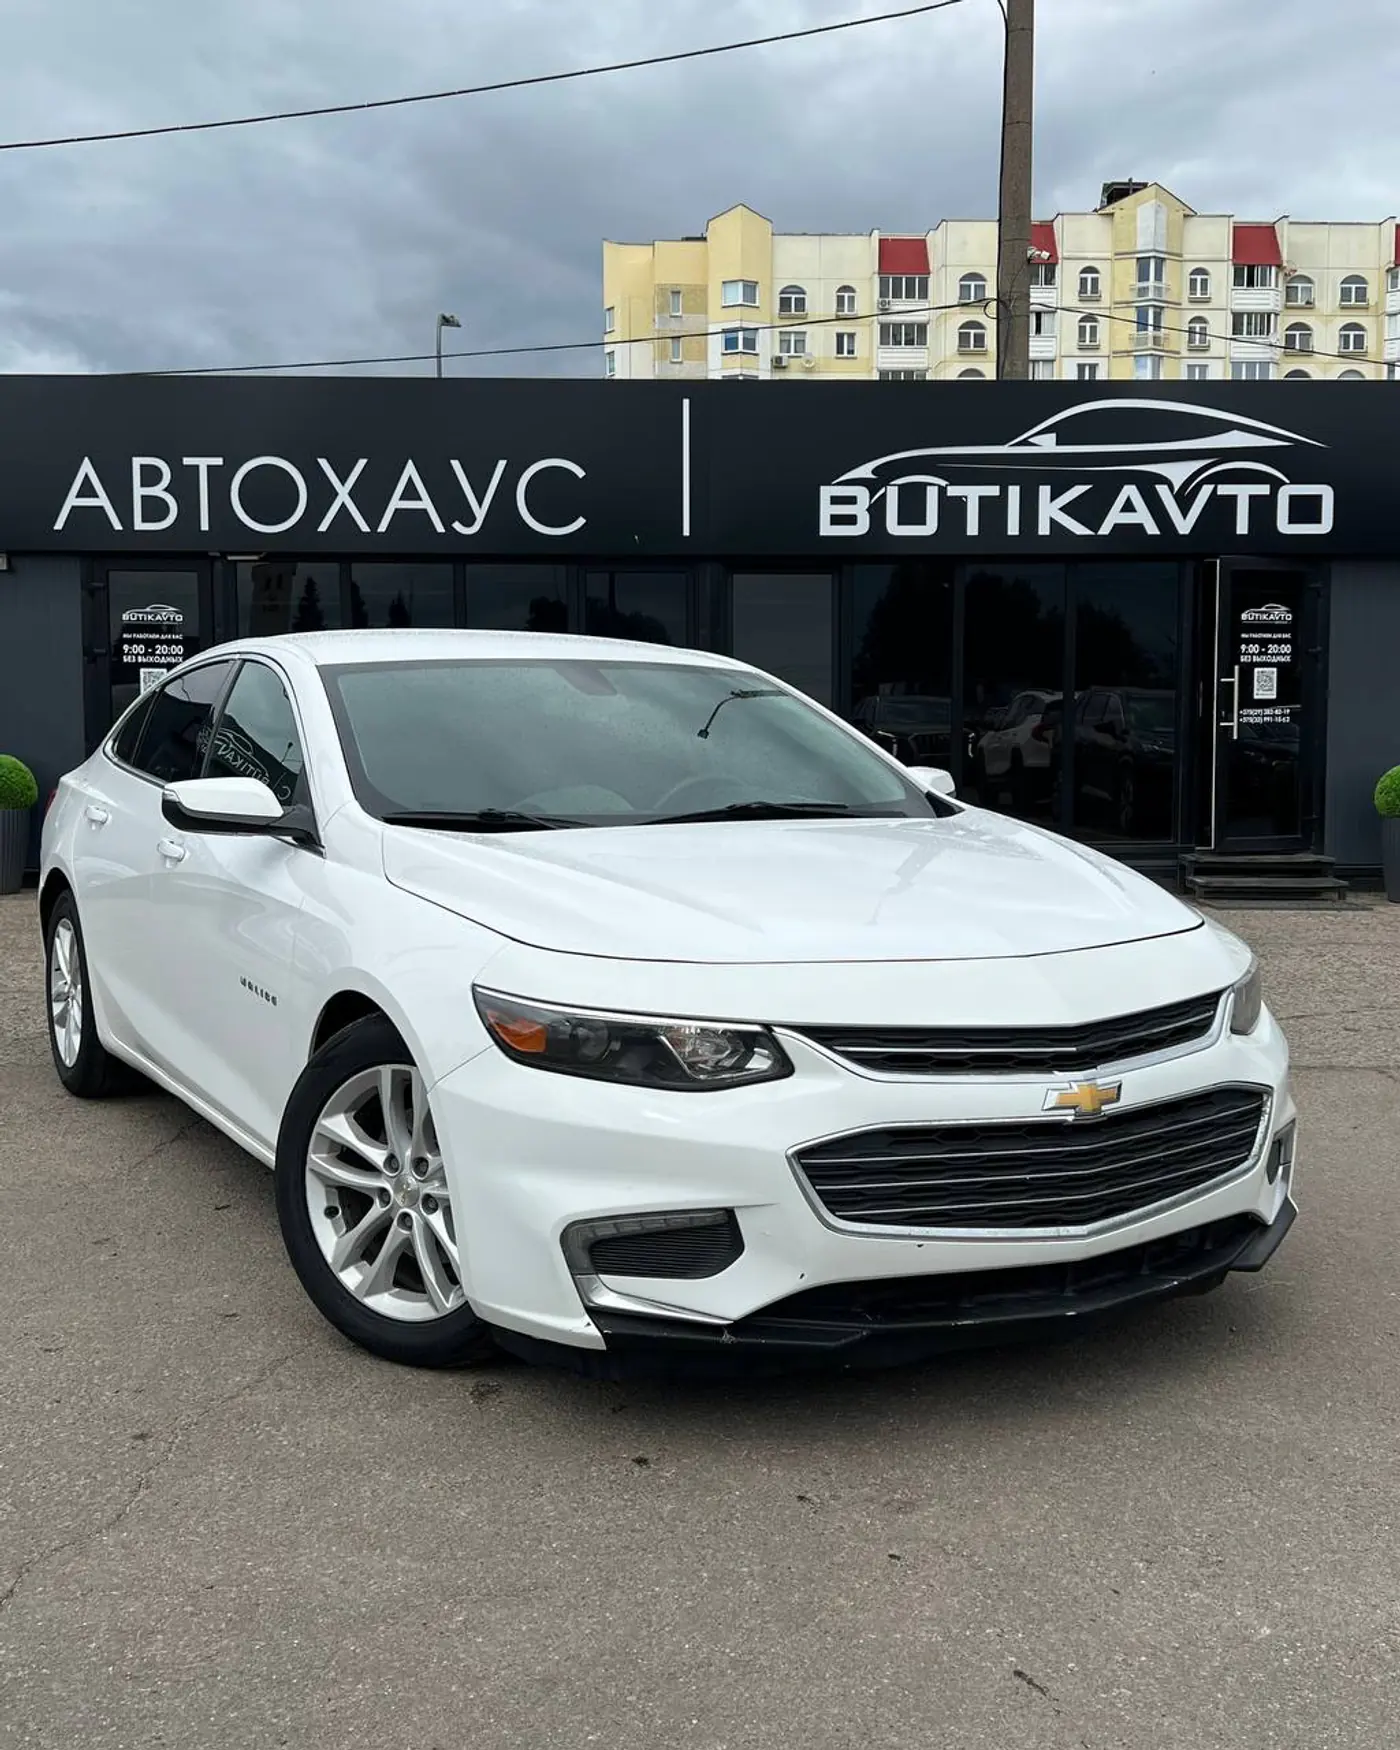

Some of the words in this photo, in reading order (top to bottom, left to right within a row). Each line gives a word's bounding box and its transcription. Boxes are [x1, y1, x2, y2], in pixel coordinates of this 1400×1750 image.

[53, 455, 587, 535] АВТОХАУС
[819, 484, 1334, 536] BUTIKAVTO
[122, 613, 183, 622] BUTIKAVTO
[123, 644, 145, 654] 9:00
[155, 644, 184, 655] 20:00
[1240, 644, 1260, 654] 9:00
[1267, 644, 1292, 654] 20:00
